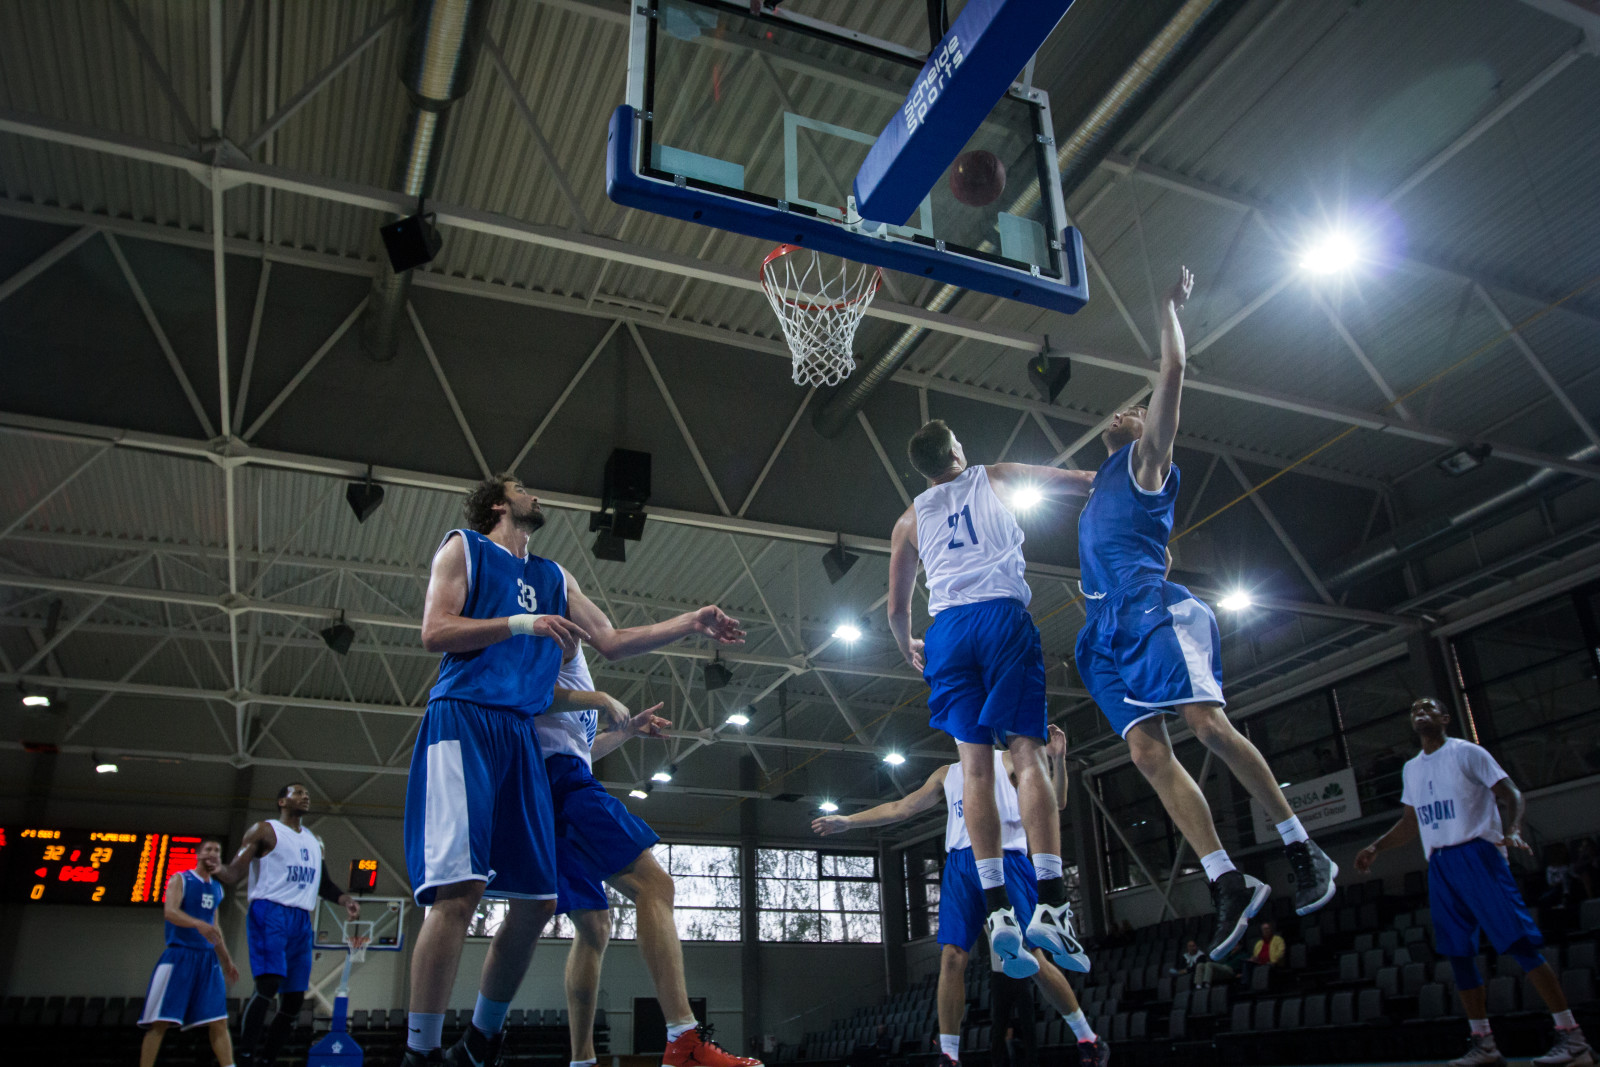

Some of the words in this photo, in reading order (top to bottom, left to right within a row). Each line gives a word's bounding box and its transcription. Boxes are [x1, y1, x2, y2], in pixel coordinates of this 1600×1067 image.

[904, 35, 960, 121] schelde
[907, 49, 963, 136] sports
[947, 504, 979, 550] 21
[517, 577, 538, 613] 33
[43, 845, 66, 861] 32
[90, 847, 113, 863] 23
[369, 870, 377, 887] 1
[30, 884, 45, 900] 0
[91, 886, 106, 902] 2
[201, 893, 215, 910] 55
